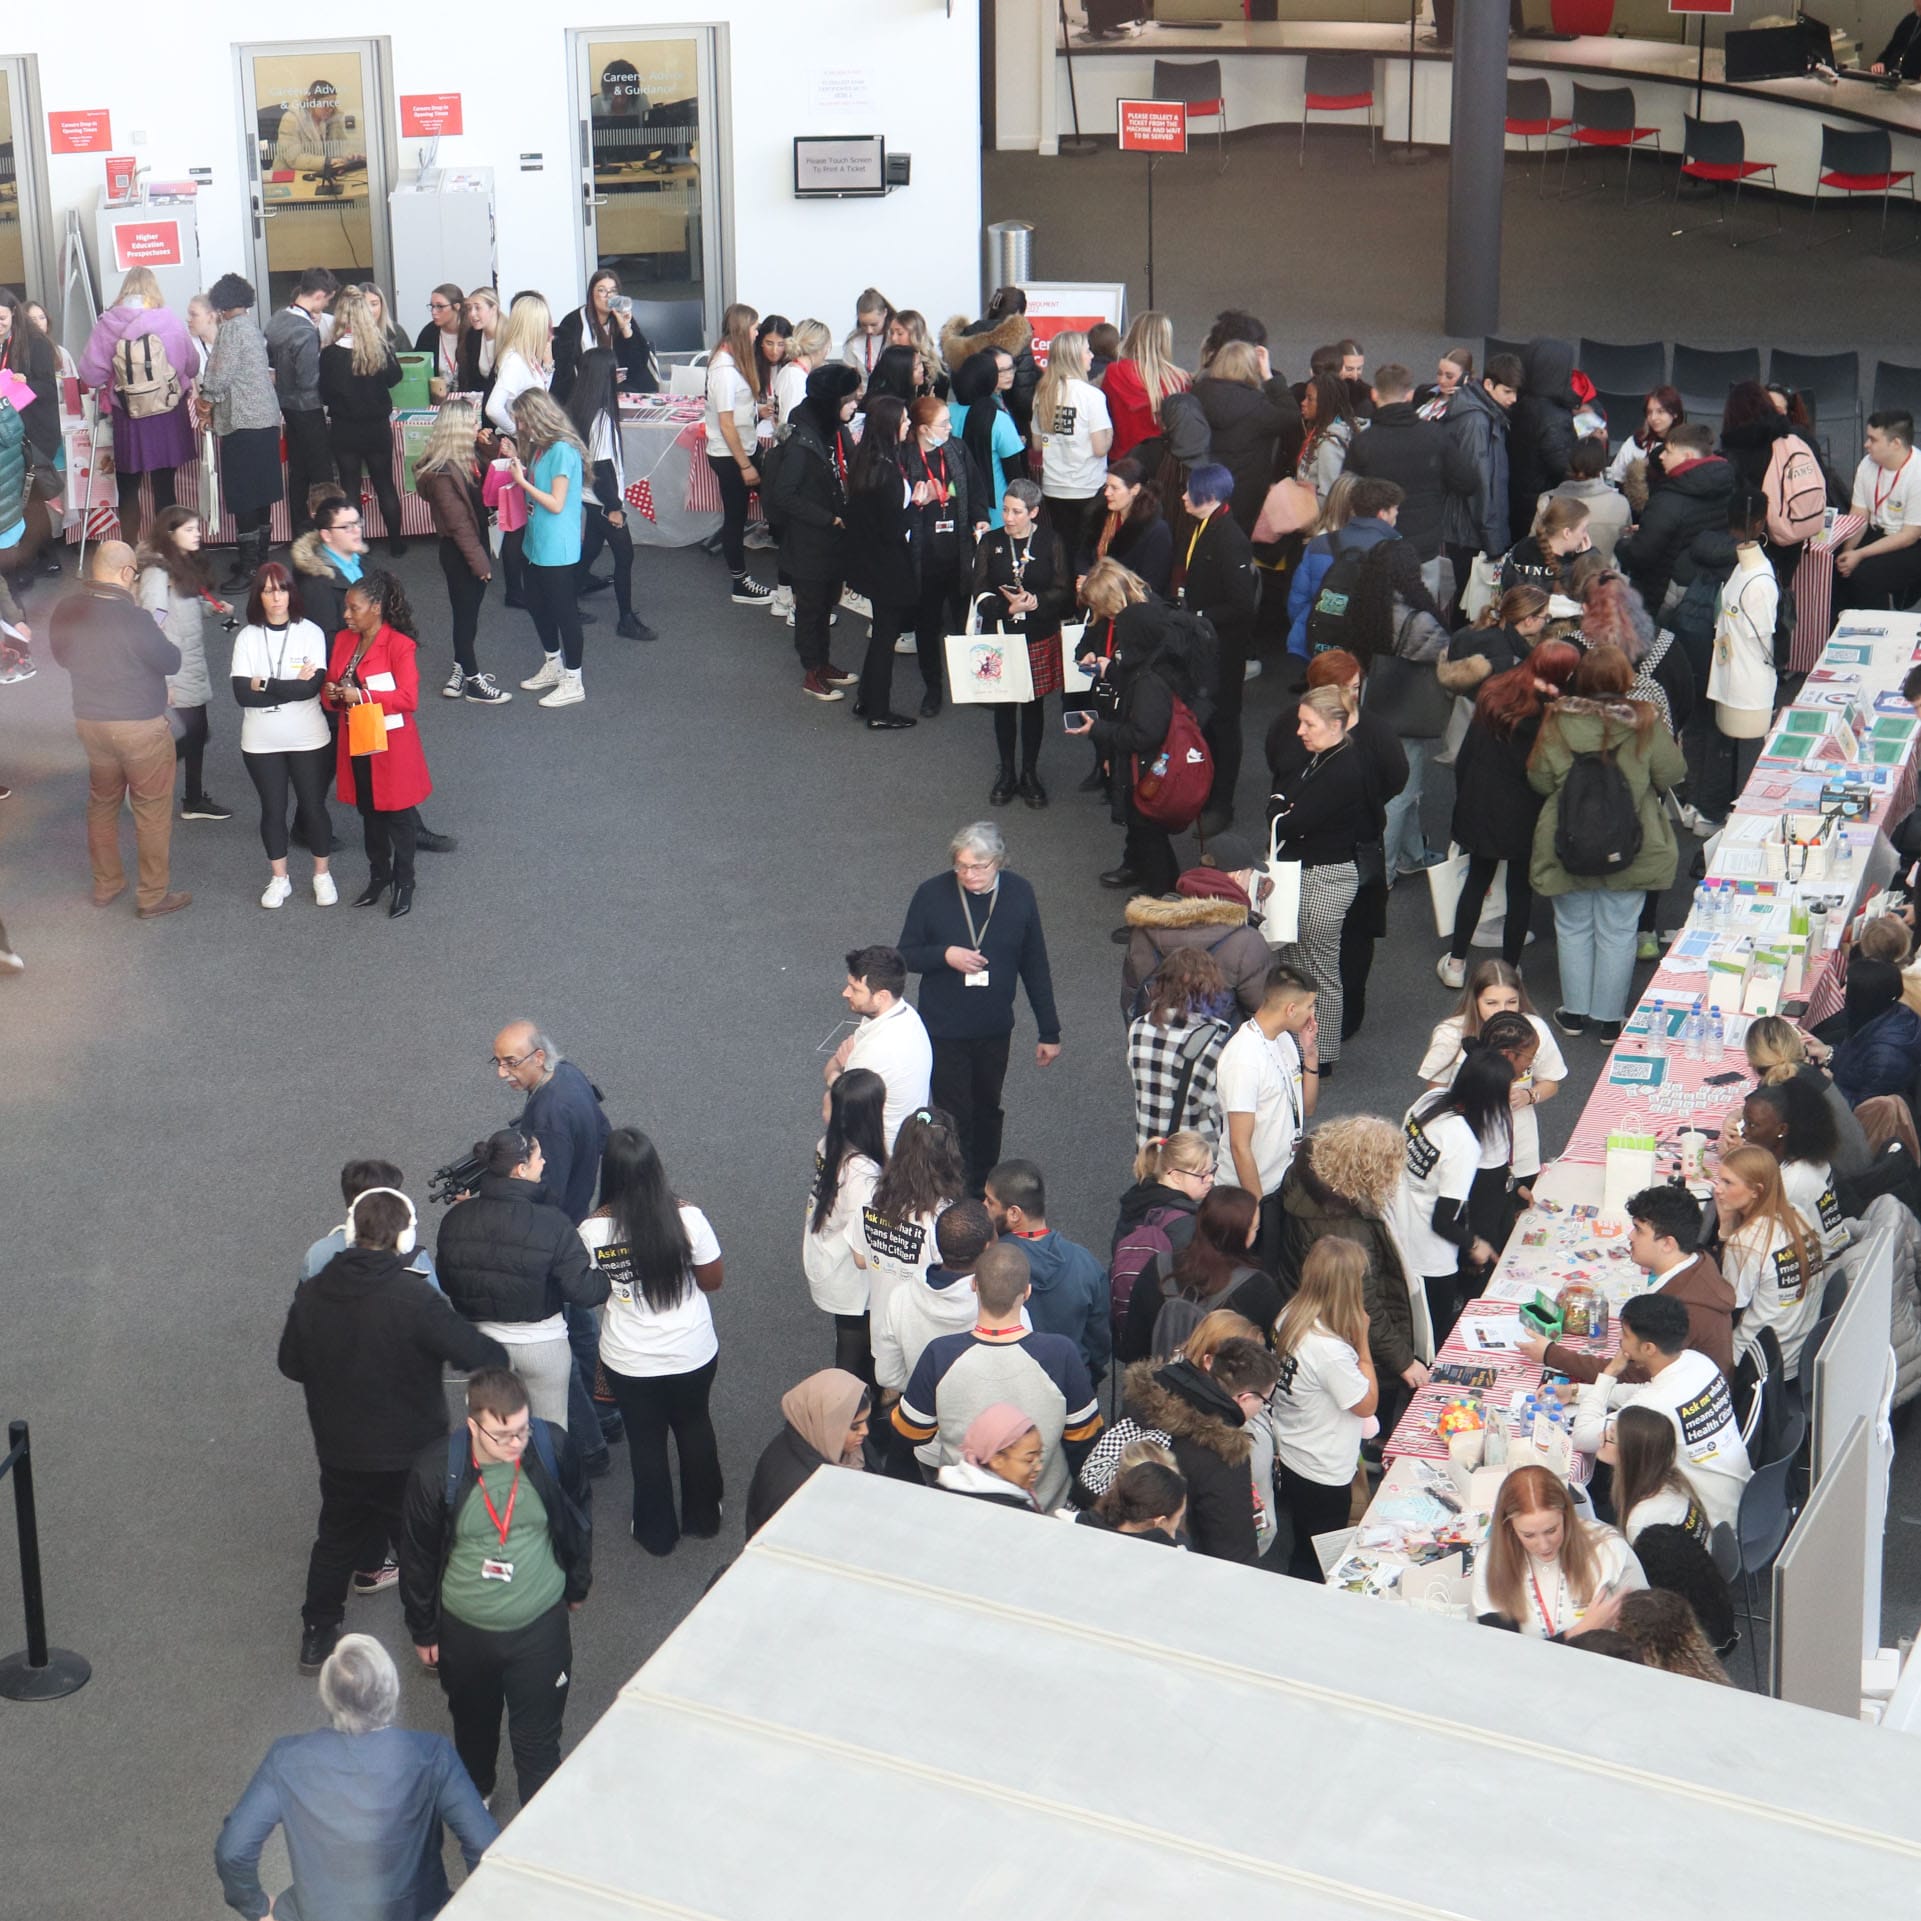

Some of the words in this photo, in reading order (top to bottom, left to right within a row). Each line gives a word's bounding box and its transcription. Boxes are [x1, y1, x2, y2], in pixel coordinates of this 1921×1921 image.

[613, 86, 622, 96] &
[280, 100, 289, 110] &
[1127, 112, 1148, 120] PLEASE
[1151, 133, 1174, 141] SERVED
[806, 157, 827, 165] Please
[850, 156, 873, 164] Screen
[847, 165, 867, 173] Ticket
[136, 233, 158, 242] Higher
[131, 241, 164, 250] Education
[126, 248, 171, 259] Prospectuses
[865, 1209, 878, 1224] Ask
[914, 1228, 923, 1239] it
[1824, 1213, 1842, 1229] Hea
[889, 1230, 909, 1250] being
[911, 1242, 918, 1250] a
[598, 1248, 617, 1260] Ask
[1777, 1248, 1795, 1263] Ask
[1780, 1261, 1800, 1275] mea
[1781, 1274, 1800, 1286] Hea
[1681, 1401, 1701, 1419] Ask
[1699, 1394, 1712, 1408] me
[1685, 1408, 1715, 1430] means
[1687, 1419, 1720, 1442] Health
